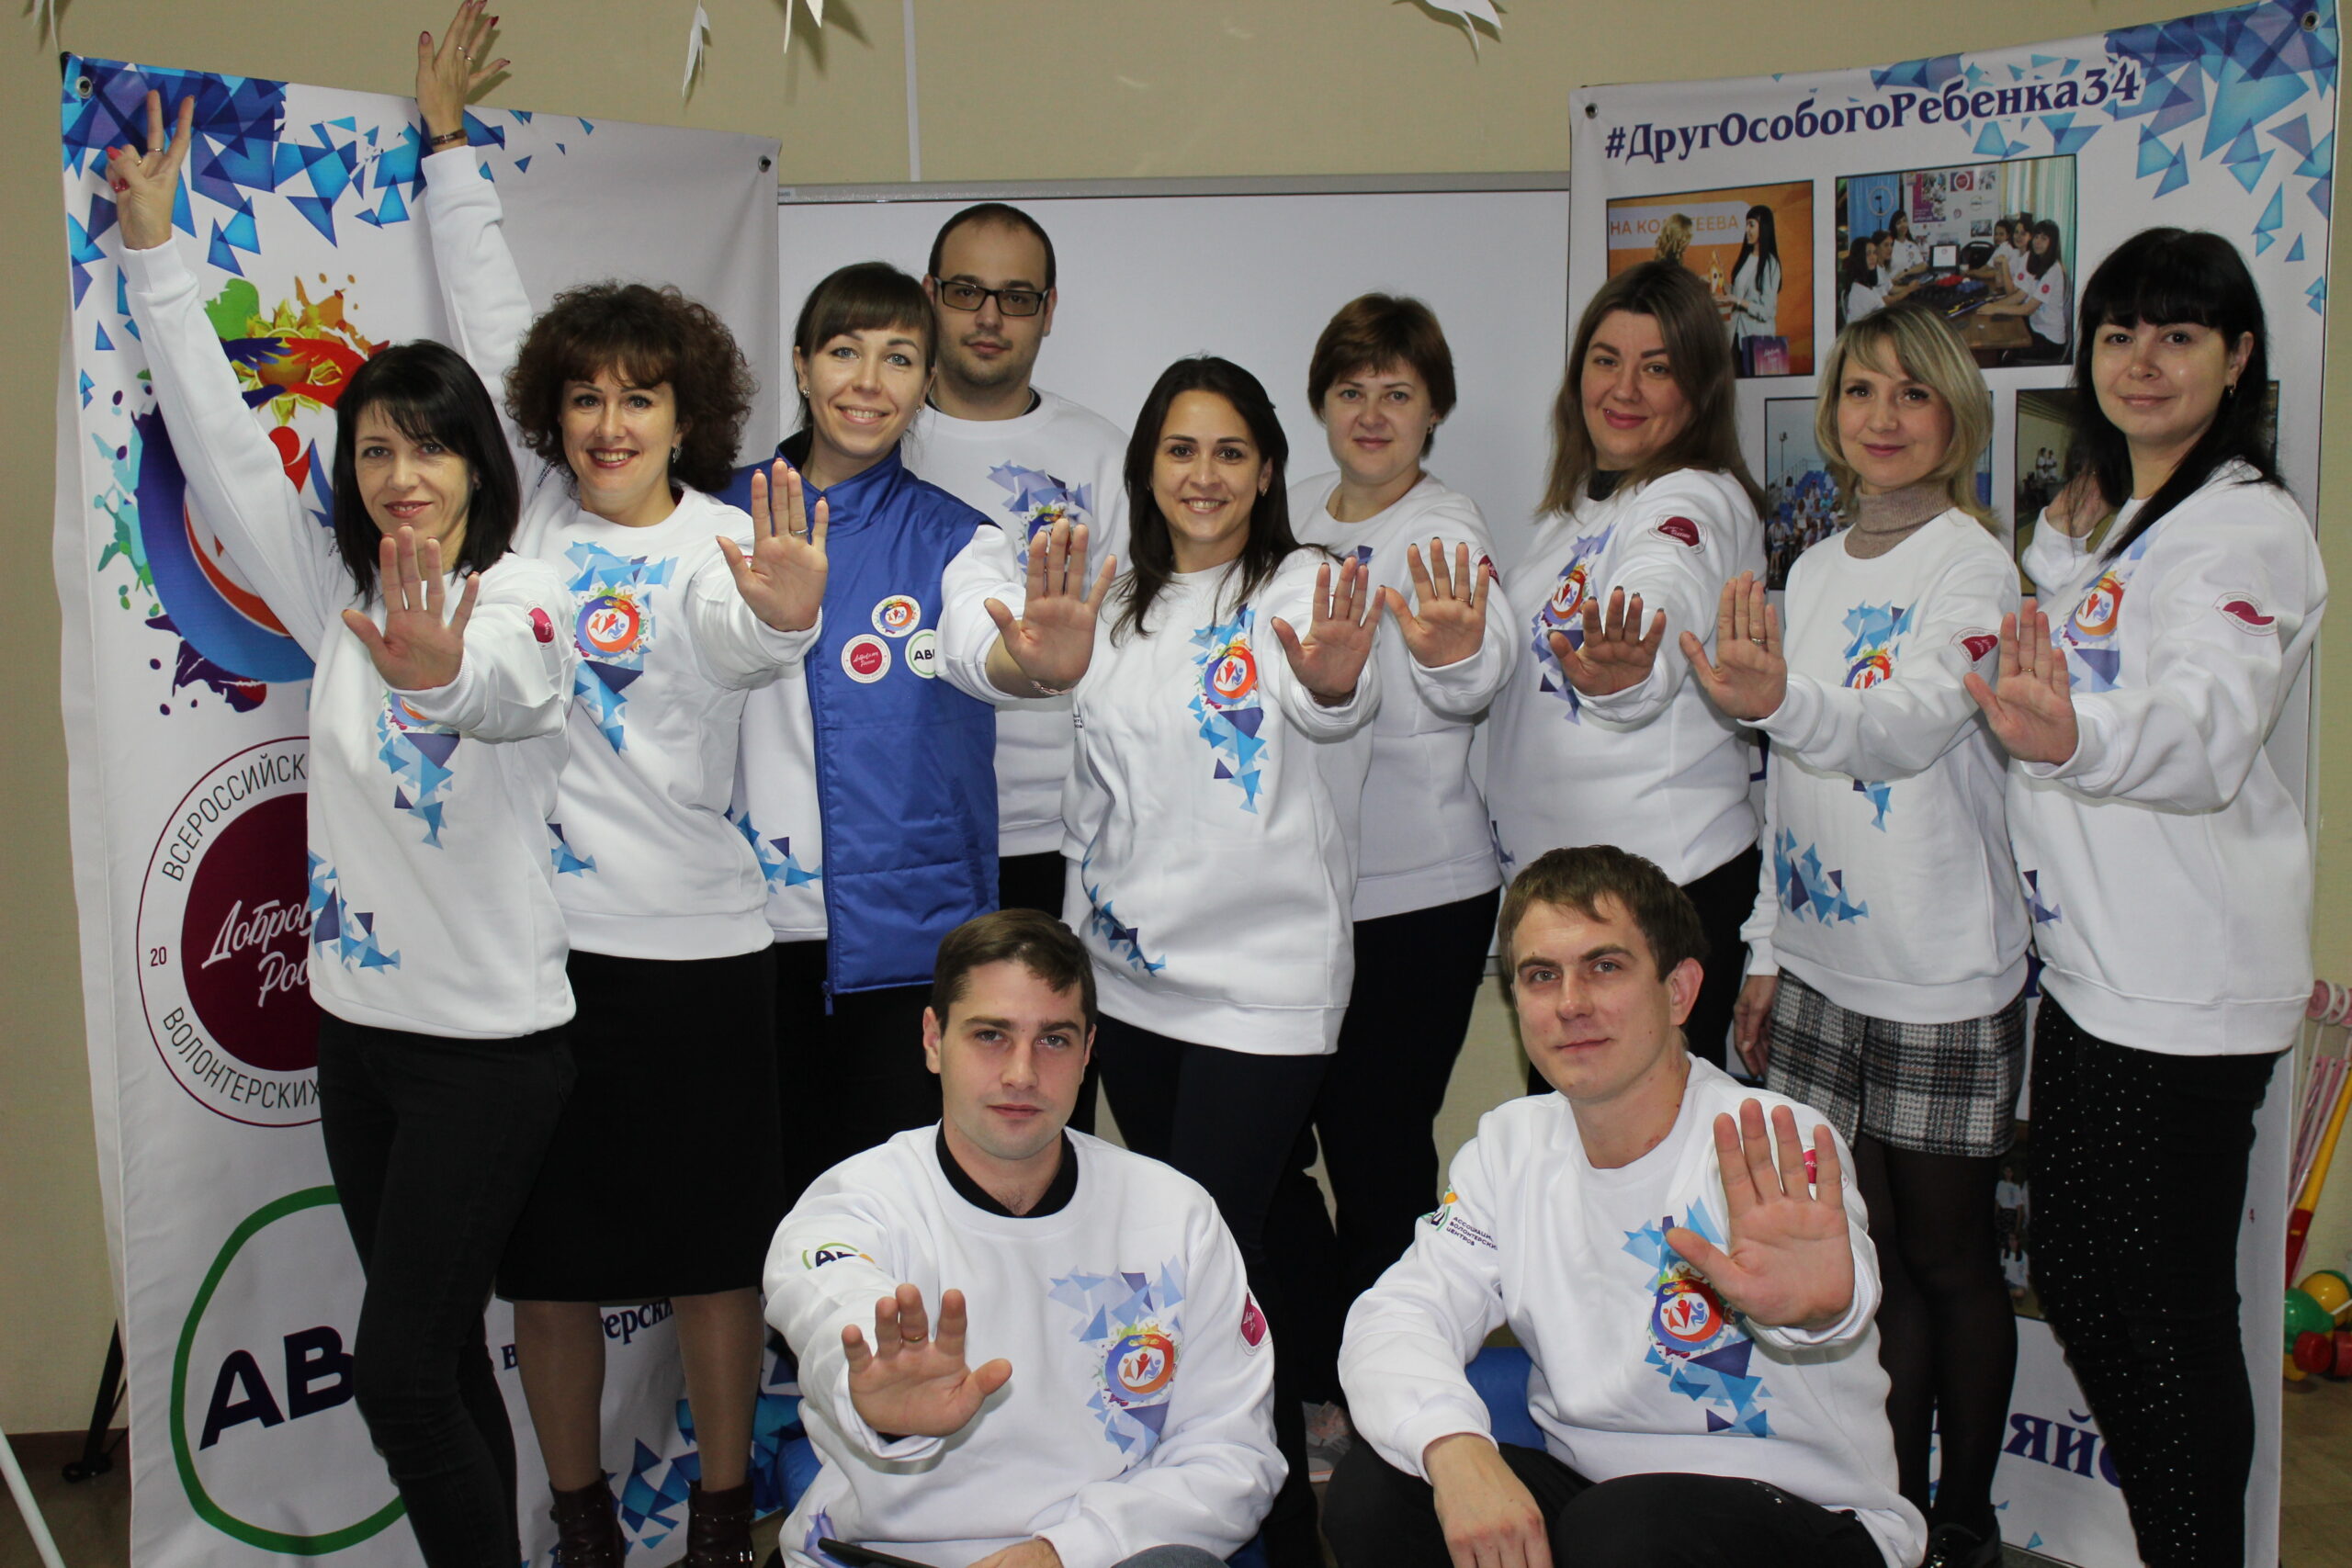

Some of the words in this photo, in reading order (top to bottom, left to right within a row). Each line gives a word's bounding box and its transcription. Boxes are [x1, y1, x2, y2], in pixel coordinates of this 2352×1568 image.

[1604, 62, 2141, 164] #ДругОсобогоРебенка34
[150, 946, 167, 967] 20
[163, 1006, 321, 1110] ВОЛОНТЕРСКИХ
[1445, 1225, 1475, 1247] ЦЕНТРОВ
[1453, 1215, 1494, 1243] АССОЦИАЦИ
